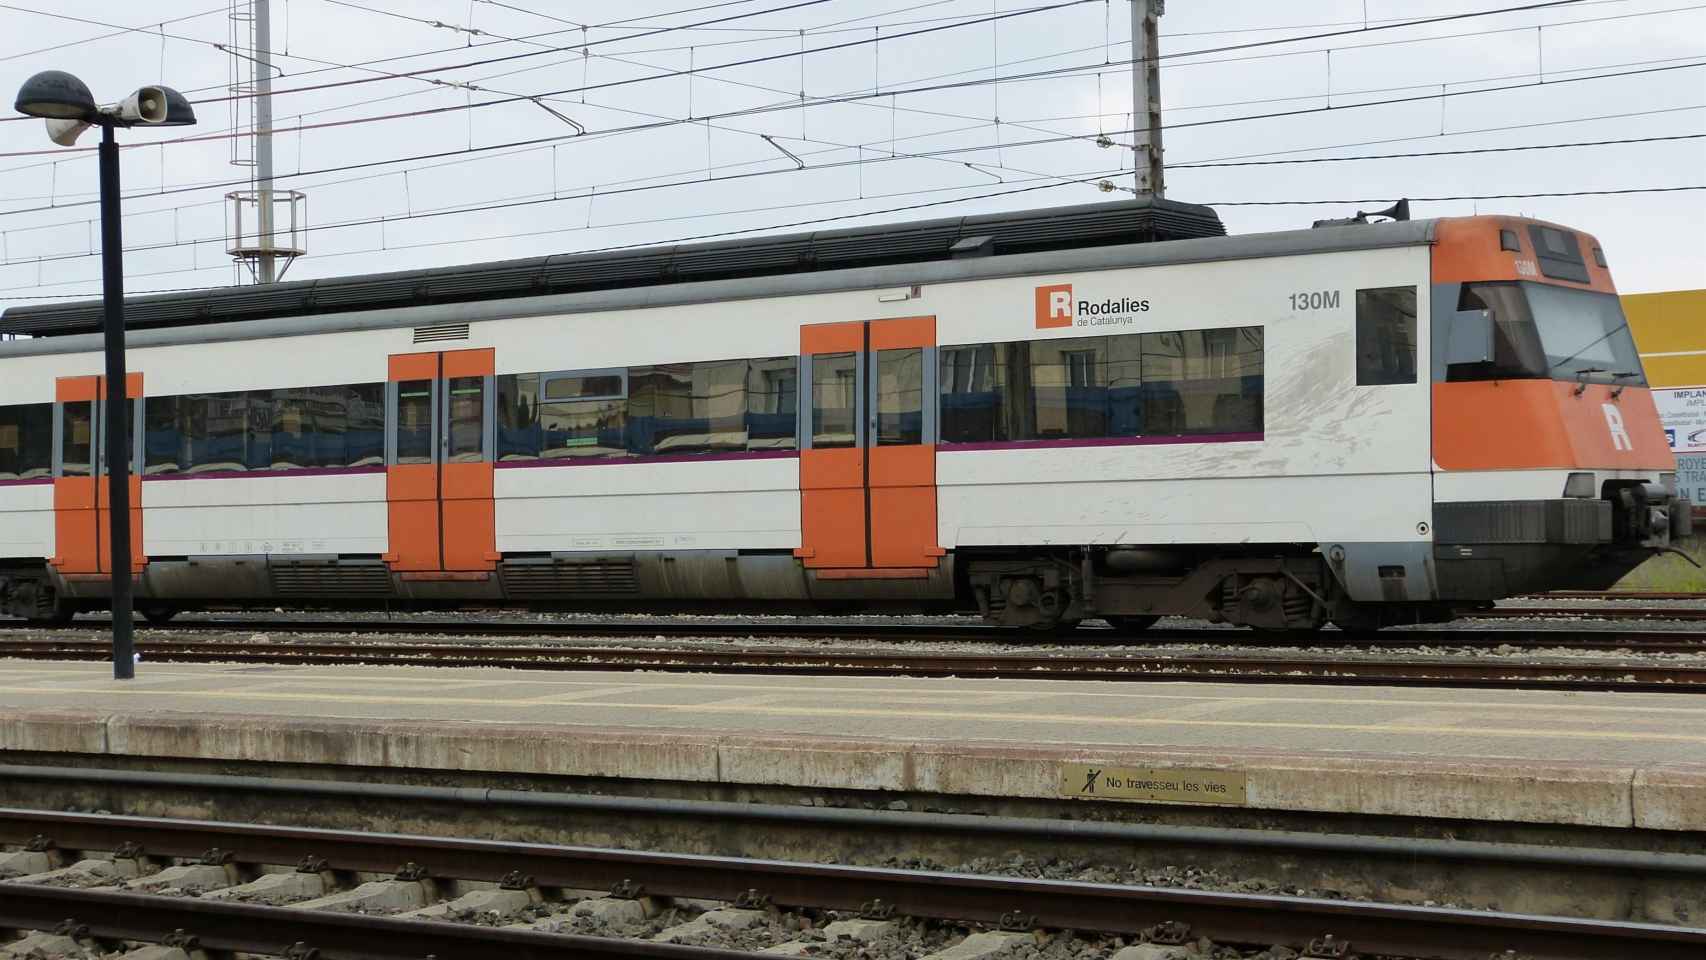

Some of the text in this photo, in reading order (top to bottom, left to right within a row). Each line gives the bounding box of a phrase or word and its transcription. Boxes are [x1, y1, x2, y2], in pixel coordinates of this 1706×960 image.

[1050, 291, 1072, 318] R
[1078, 298, 1150, 316] Rodalies
[1288, 290, 1340, 310] 130M
[1077, 316, 1133, 327] de Catalunya
[1601, 403, 1633, 451] R
[1106, 777, 1226, 793] No travesseu les vies
